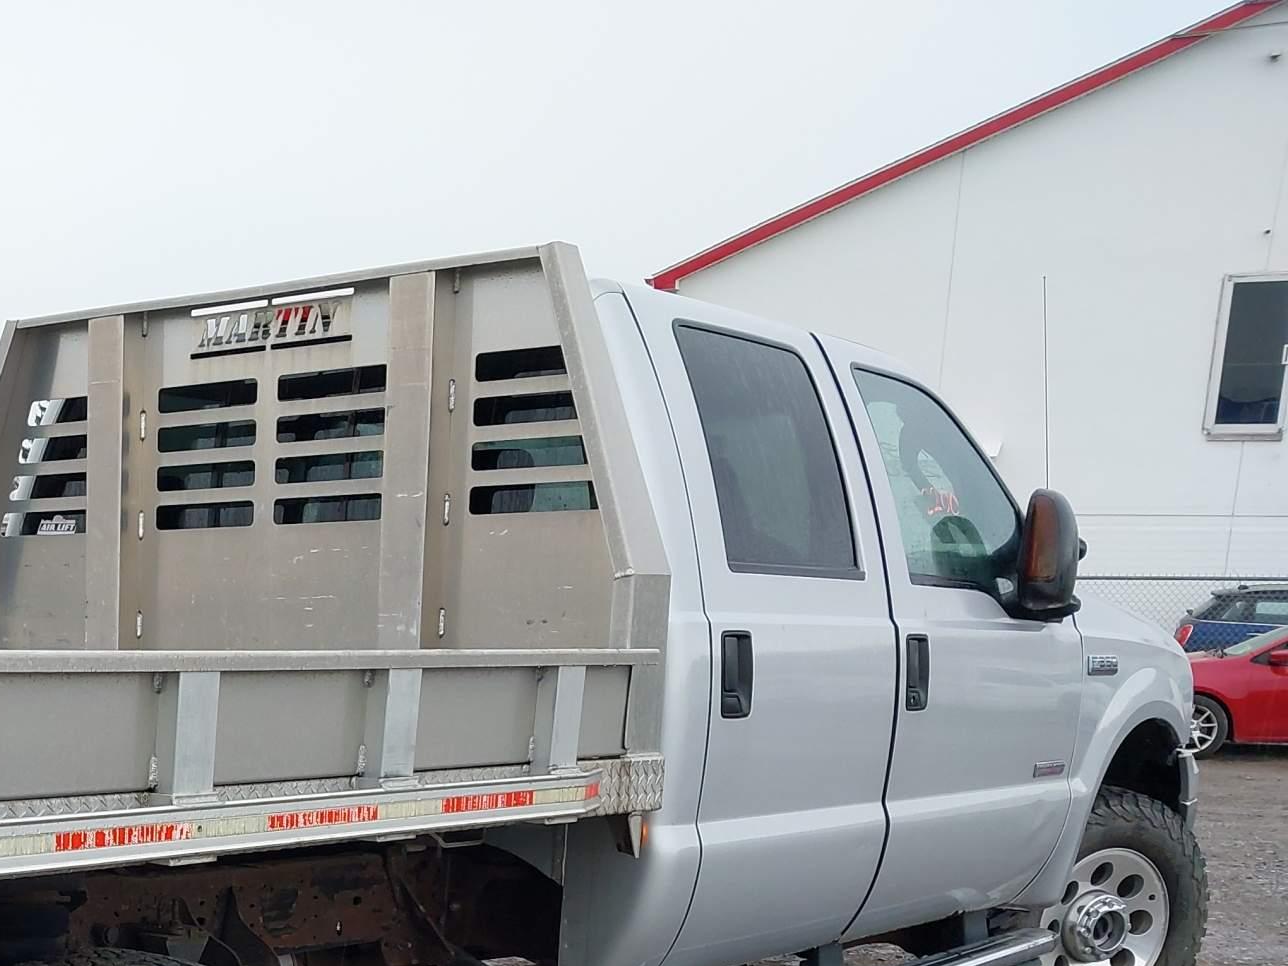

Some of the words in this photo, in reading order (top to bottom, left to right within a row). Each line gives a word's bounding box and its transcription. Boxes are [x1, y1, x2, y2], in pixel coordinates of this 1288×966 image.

[198, 302, 341, 348] MARTIN
[40, 523, 56, 531] AIR
[56, 523, 75, 531] LIFT
